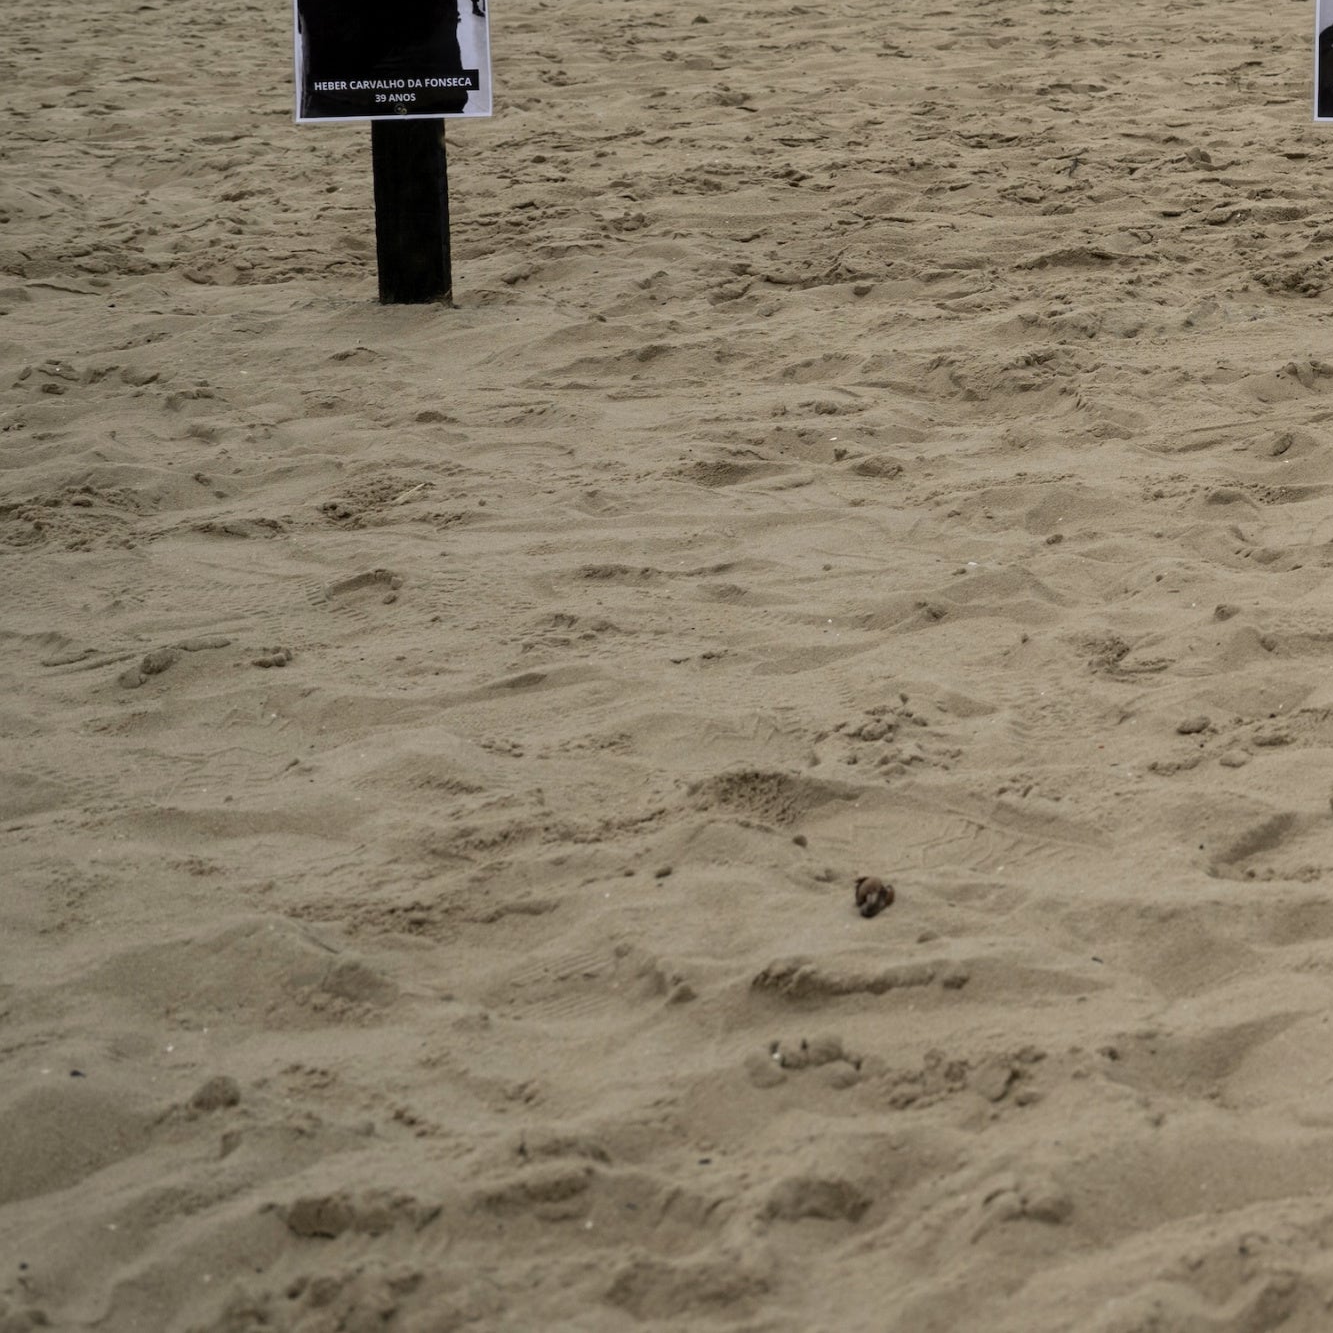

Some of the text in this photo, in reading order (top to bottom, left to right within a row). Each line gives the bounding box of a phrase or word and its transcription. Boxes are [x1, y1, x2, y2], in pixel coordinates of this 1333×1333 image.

[314, 77, 472, 91] HEBER CARVALHO DA FONSECA
[375, 93, 416, 103] 39 ANOS
